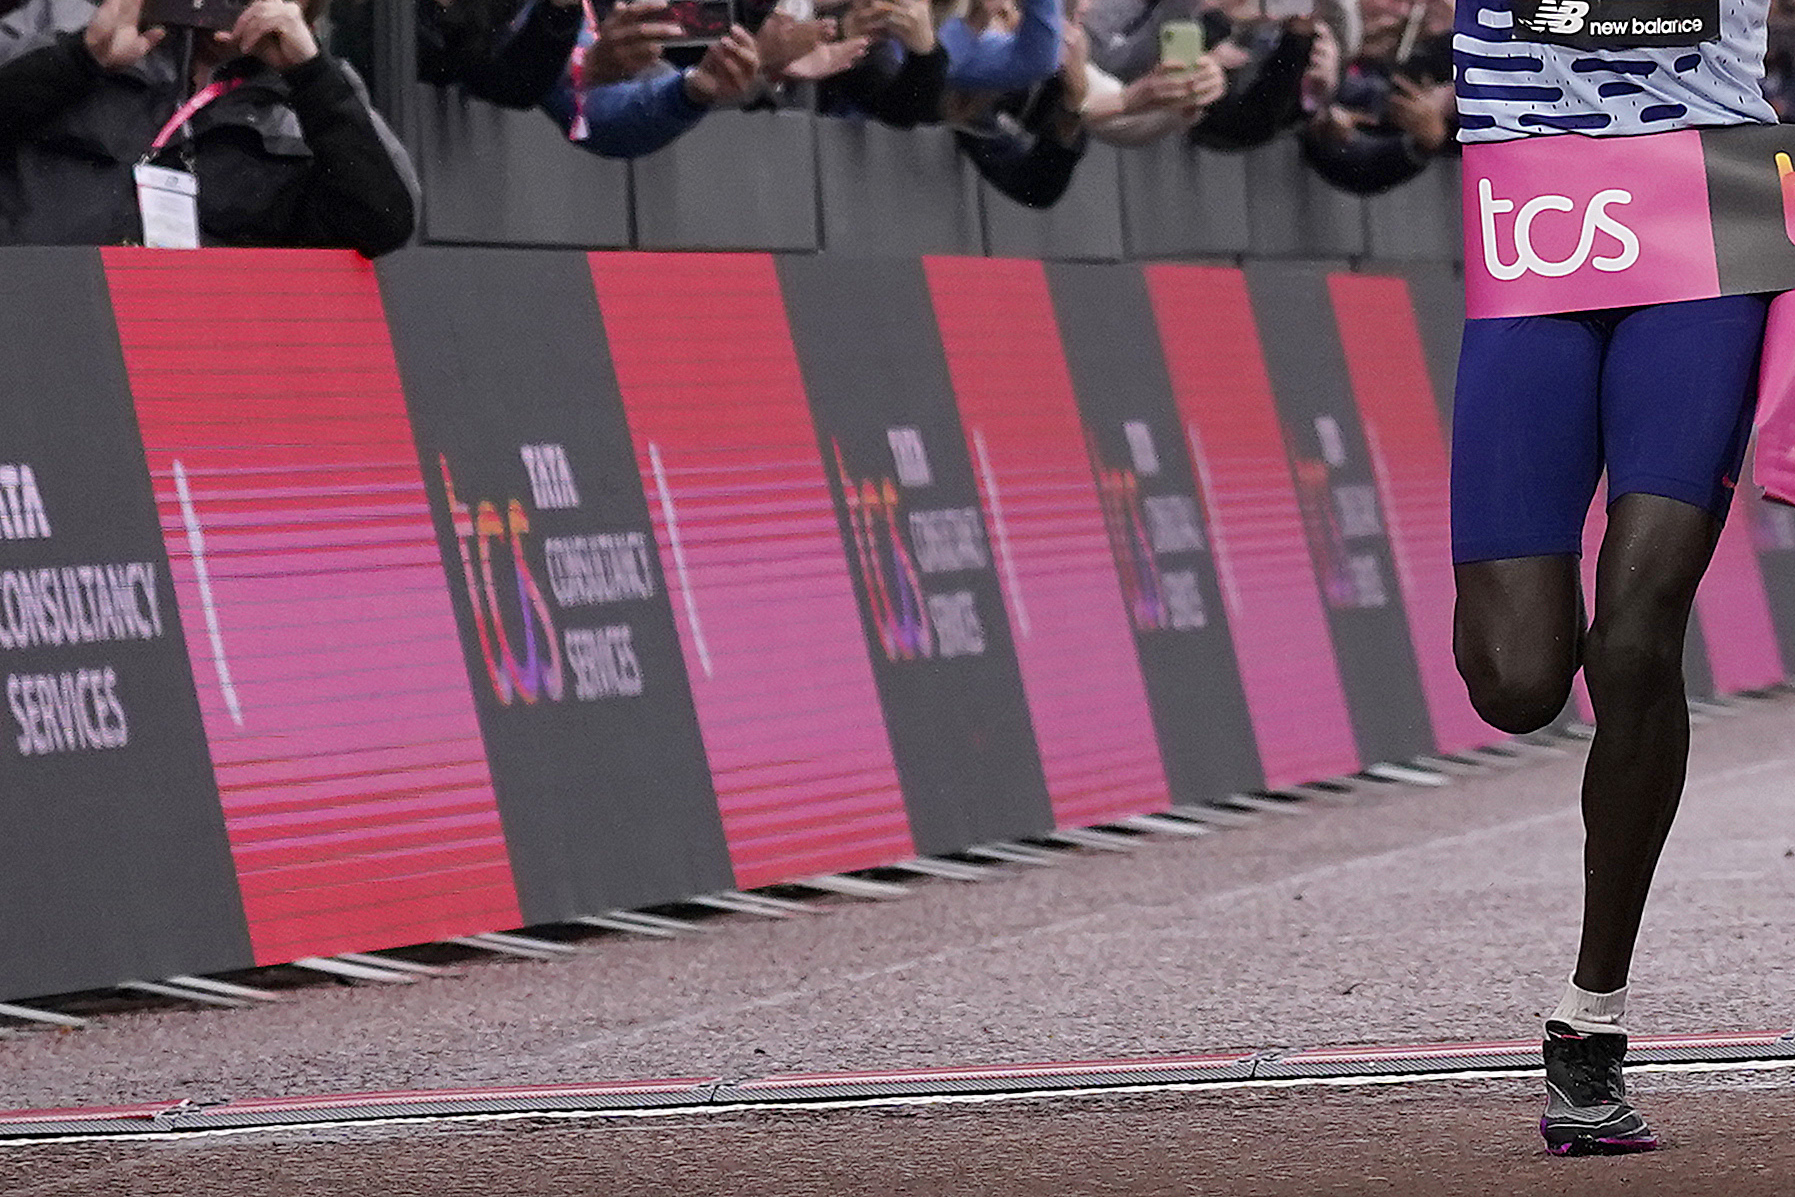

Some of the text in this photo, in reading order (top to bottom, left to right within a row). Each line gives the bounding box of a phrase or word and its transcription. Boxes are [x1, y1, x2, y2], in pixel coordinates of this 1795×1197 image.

[1590, 20, 1629, 35] new
[1632, 18, 1703, 35] balance
[1478, 178, 1640, 281] tcs
[438, 452, 563, 705] tcs
[6, 667, 129, 756] SERVICES
